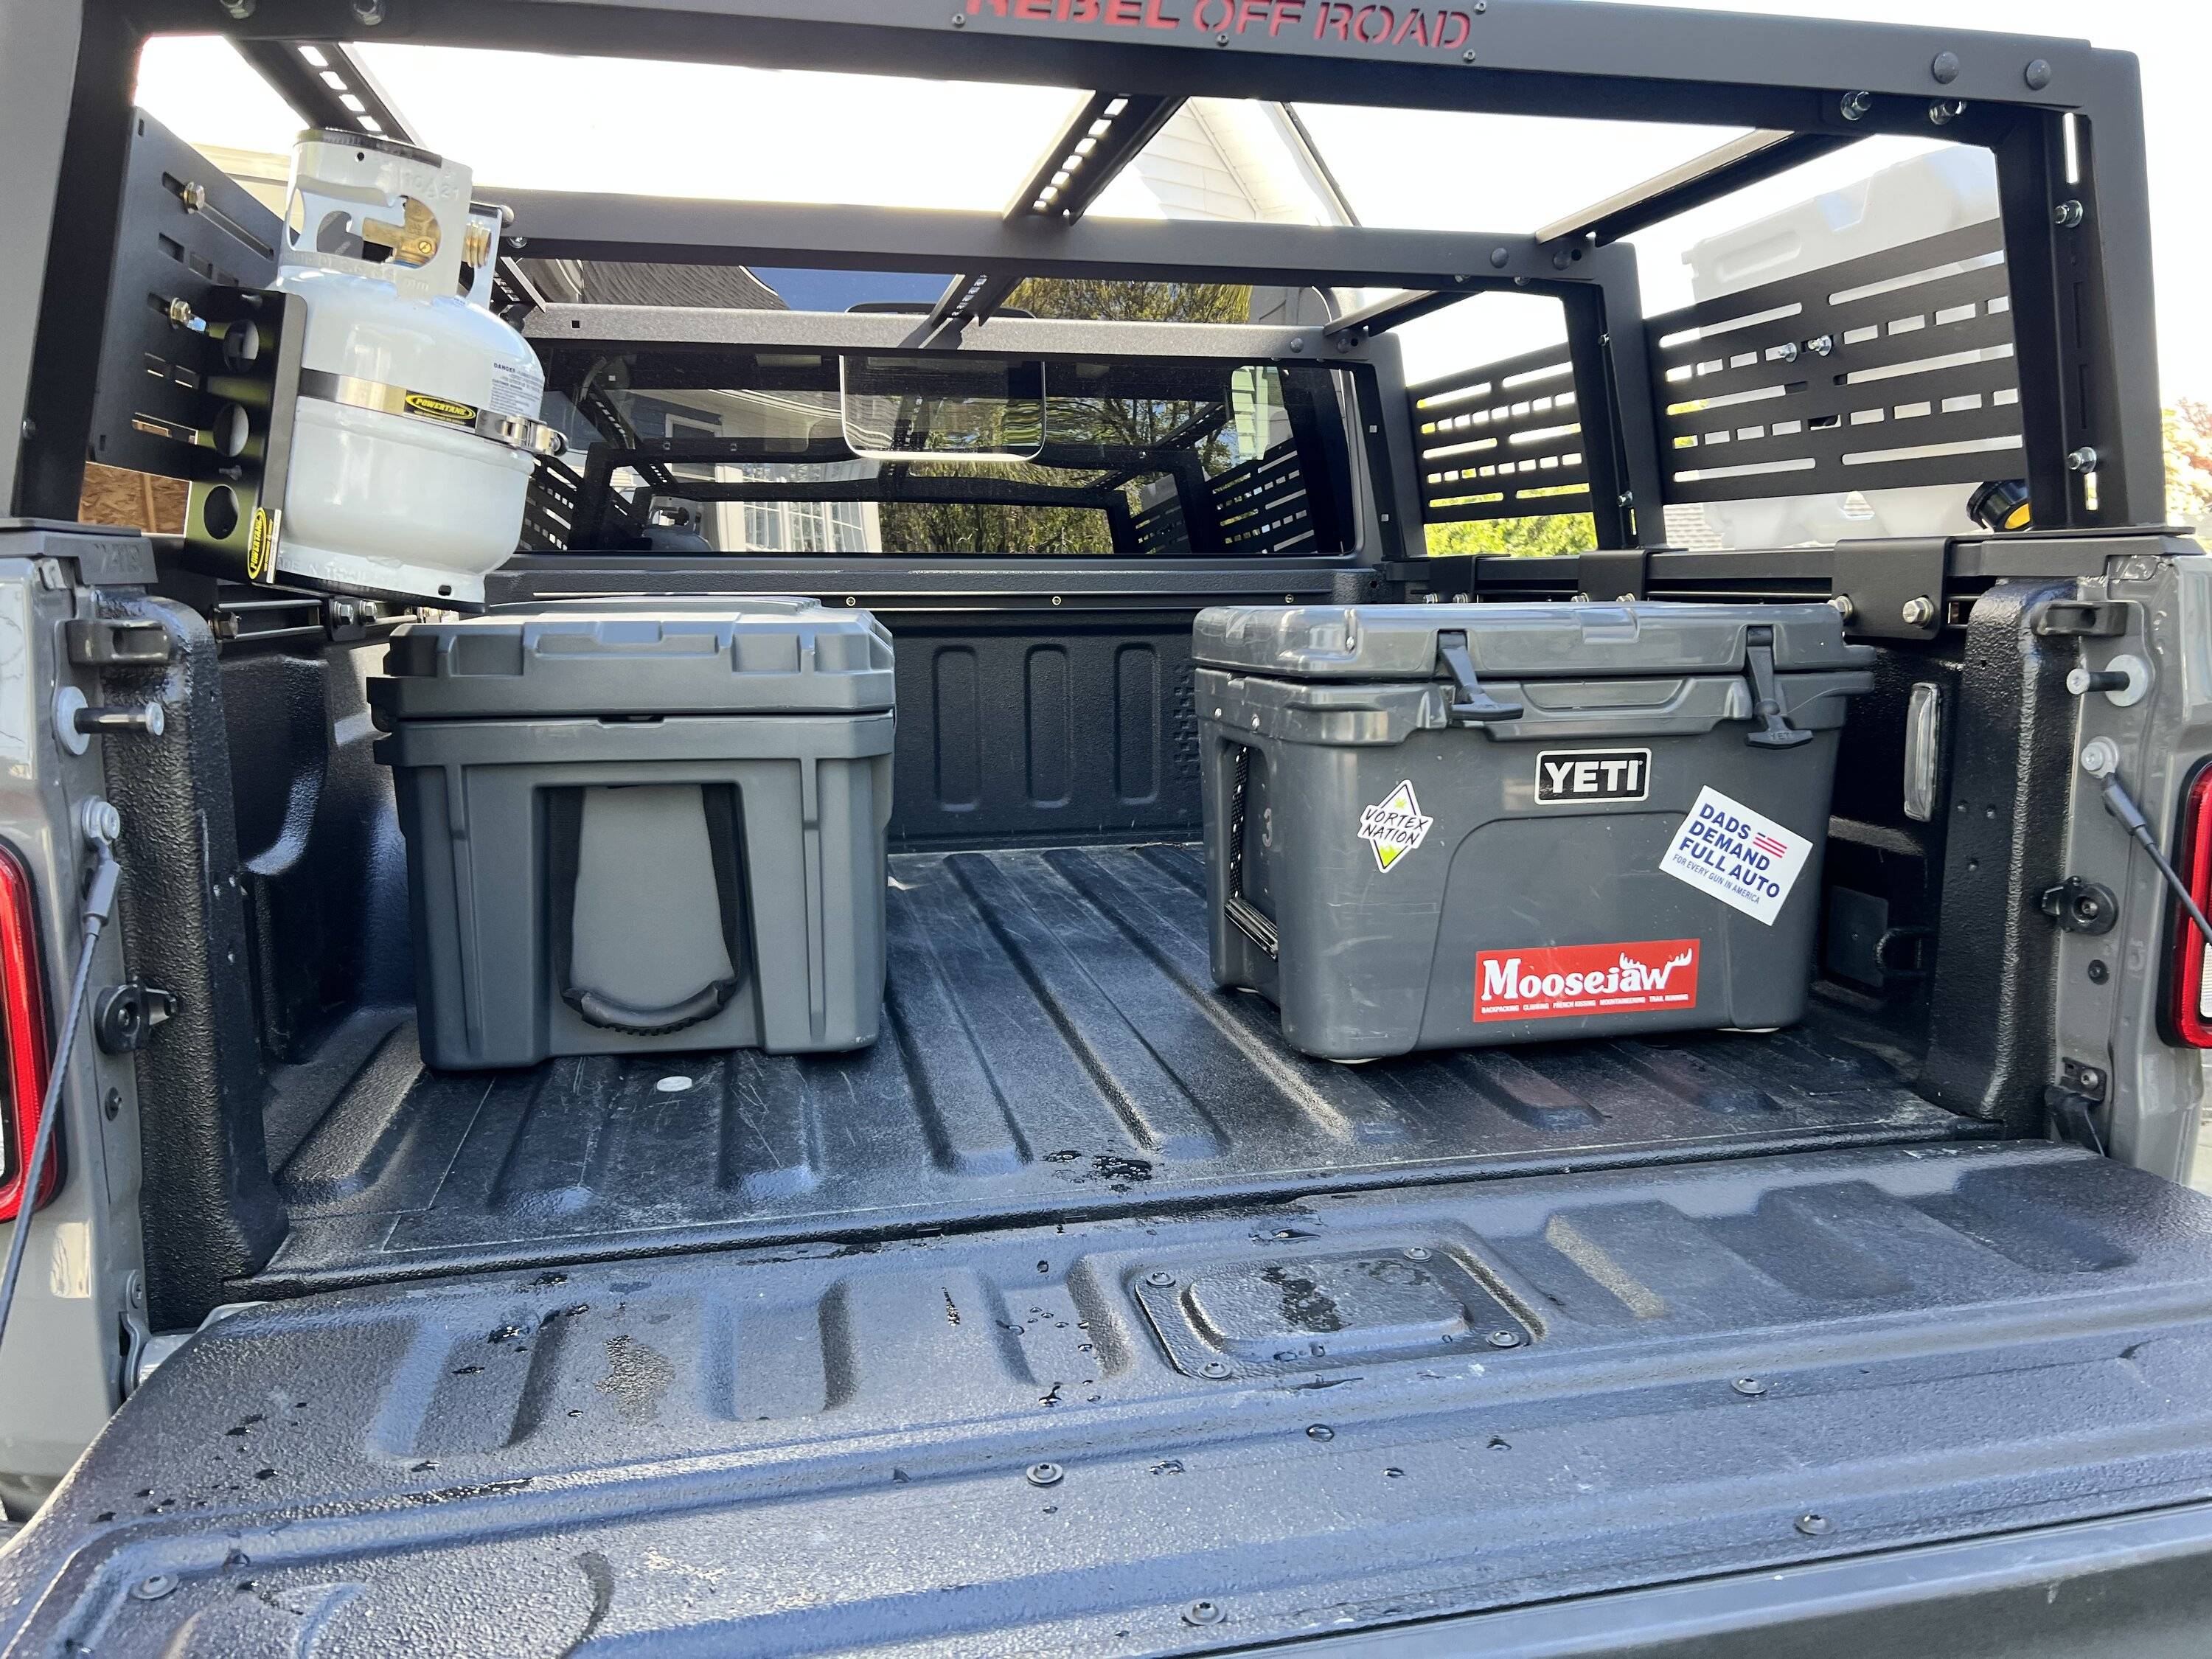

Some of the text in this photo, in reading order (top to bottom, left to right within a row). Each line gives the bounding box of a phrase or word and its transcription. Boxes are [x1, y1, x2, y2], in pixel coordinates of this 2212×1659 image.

[1192, 0, 1306, 38] OFF
[1313, 2, 1470, 49] ROAD
[414, 397, 467, 416] POWERTANK
[250, 518, 262, 571] POWERTANK
[1544, 760, 1639, 793] YETI
[1362, 823, 1420, 845] NATION
[1366, 809, 1429, 832] VORTEX
[1699, 803, 1751, 840] DADS
[1679, 836, 1781, 898] FULL AUTO
[1688, 820, 1770, 871] DEMAND
[1672, 854, 1761, 904] FOR EVERY GUN IN AMERICA
[1481, 948, 1692, 1001] Moosejaw
[1481, 1004, 1520, 1014] BACKPACKING
